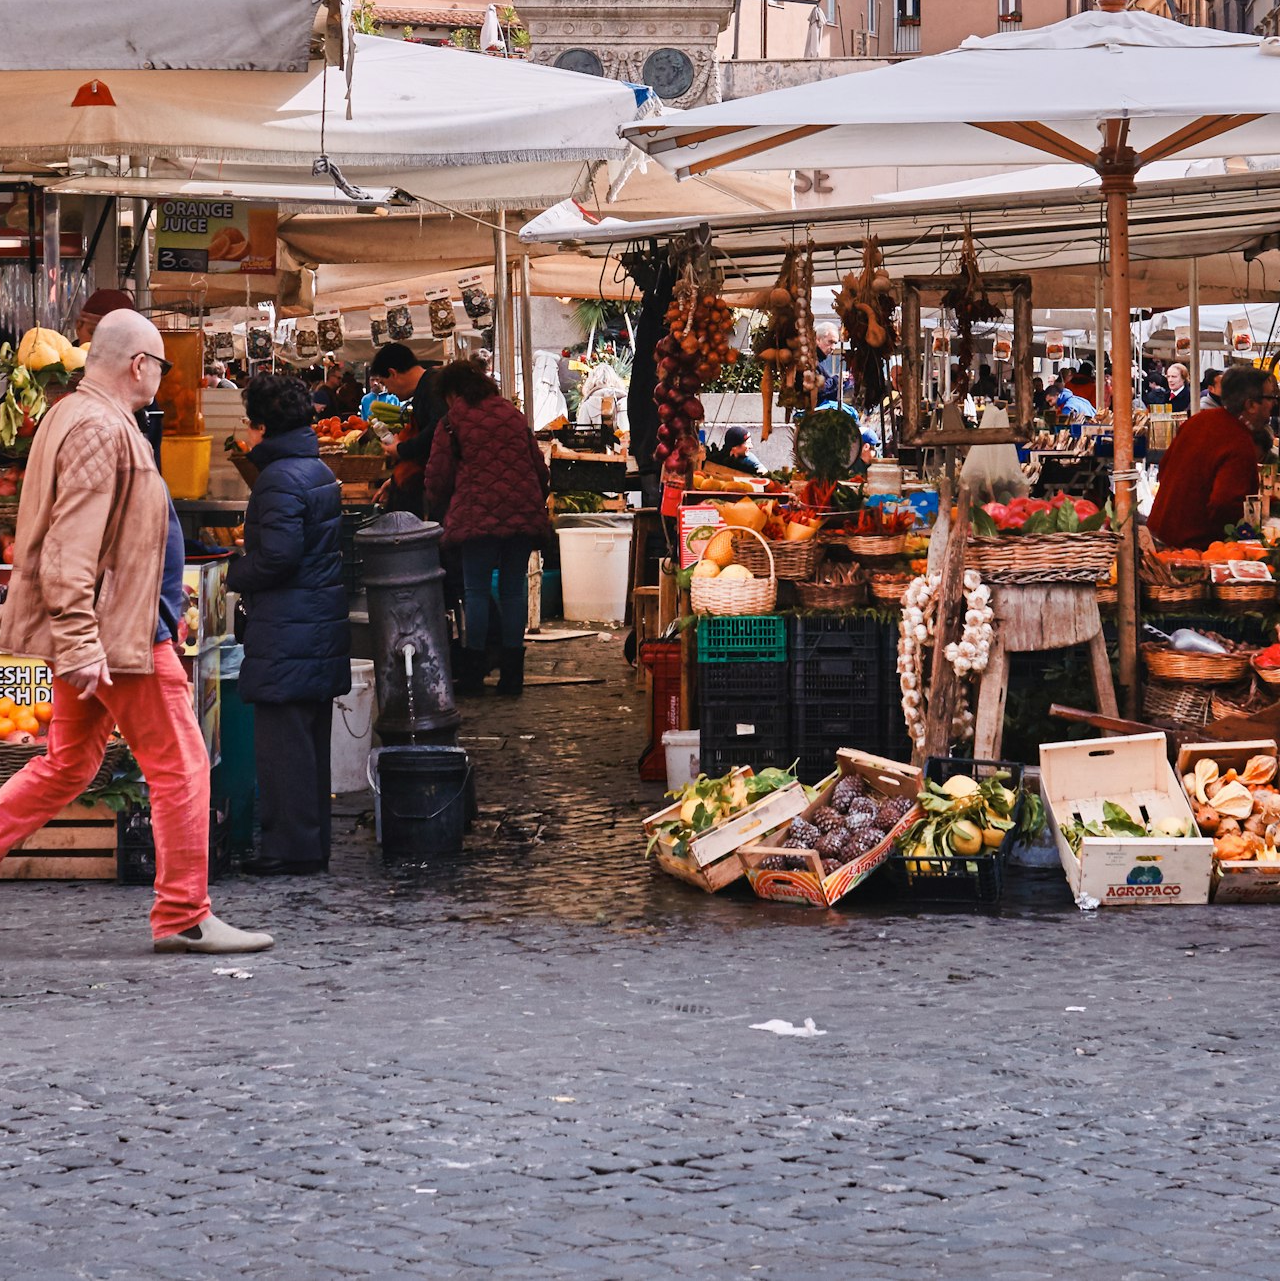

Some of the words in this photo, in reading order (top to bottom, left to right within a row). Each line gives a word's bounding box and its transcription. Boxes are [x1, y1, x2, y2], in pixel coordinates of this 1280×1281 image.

[162, 201, 234, 219] ORANGE
[161, 218, 208, 235] JUICE
[1106, 885, 1182, 898] AGROPACO
